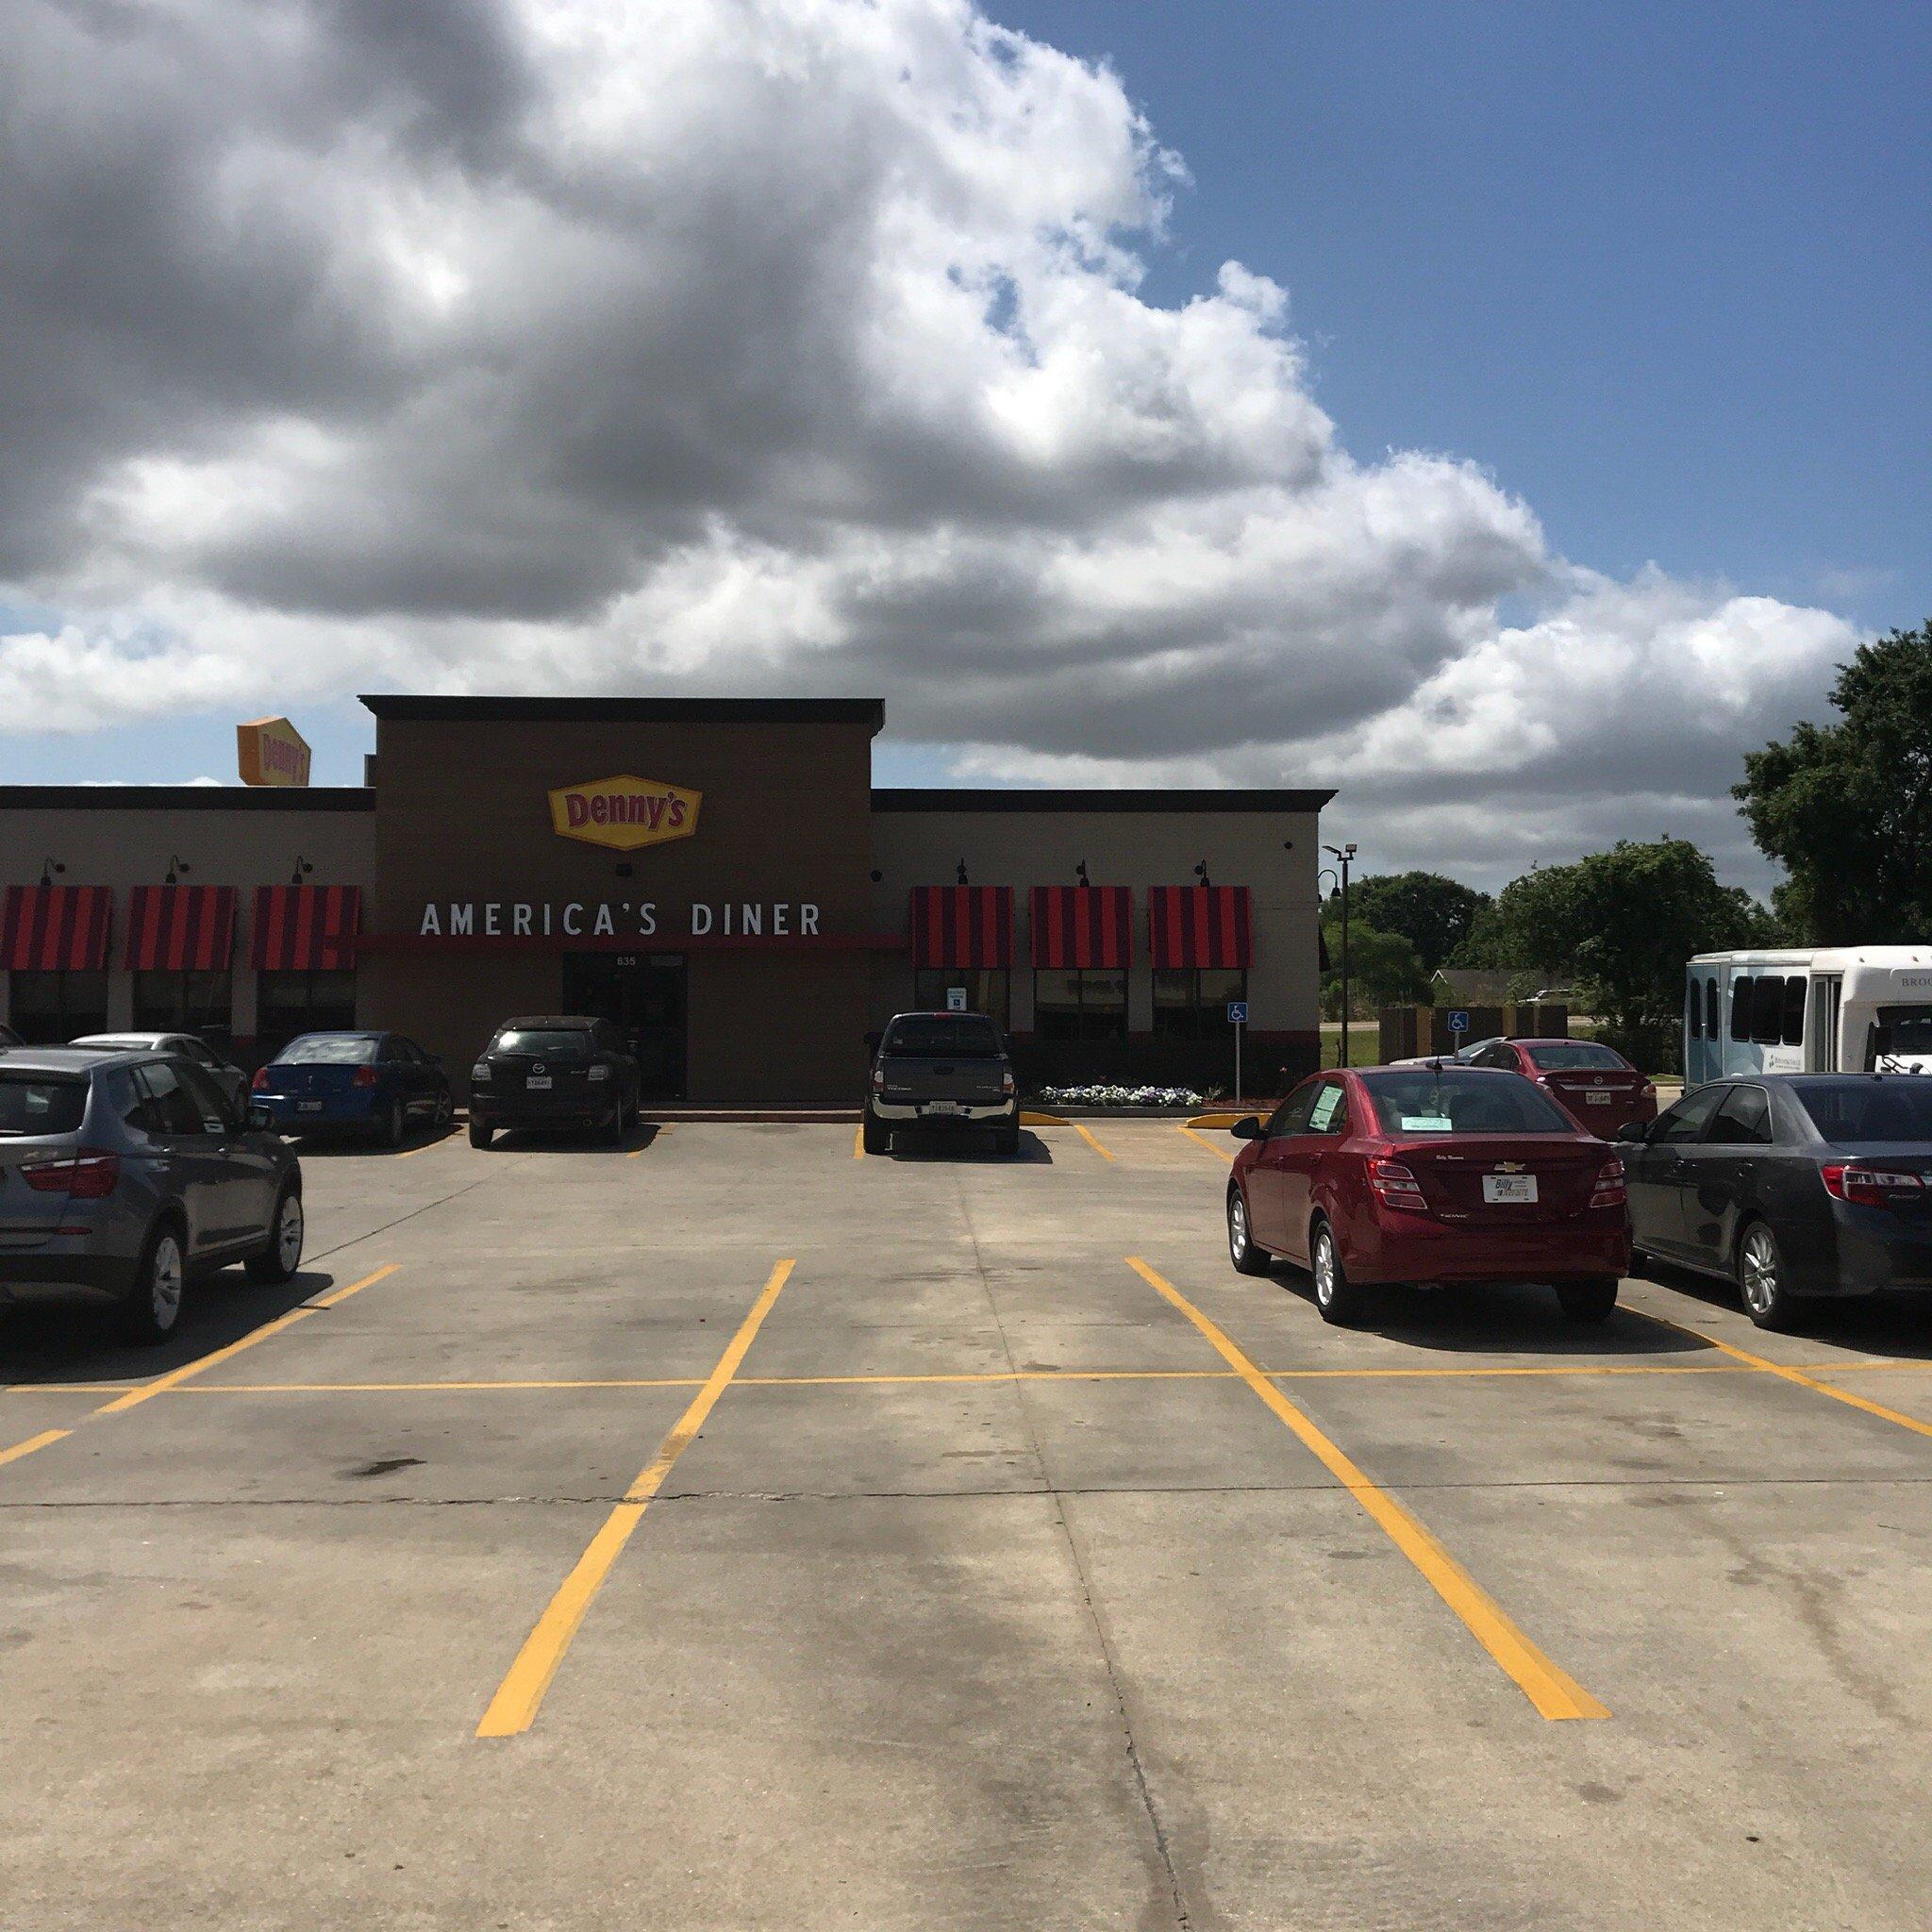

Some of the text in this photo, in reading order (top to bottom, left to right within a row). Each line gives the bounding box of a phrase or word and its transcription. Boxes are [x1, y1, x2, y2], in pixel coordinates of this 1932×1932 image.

[565, 791, 686, 830] Denny's
[420, 903, 820, 936] AMERICA'S DINER
[617, 956, 636, 966] 635
